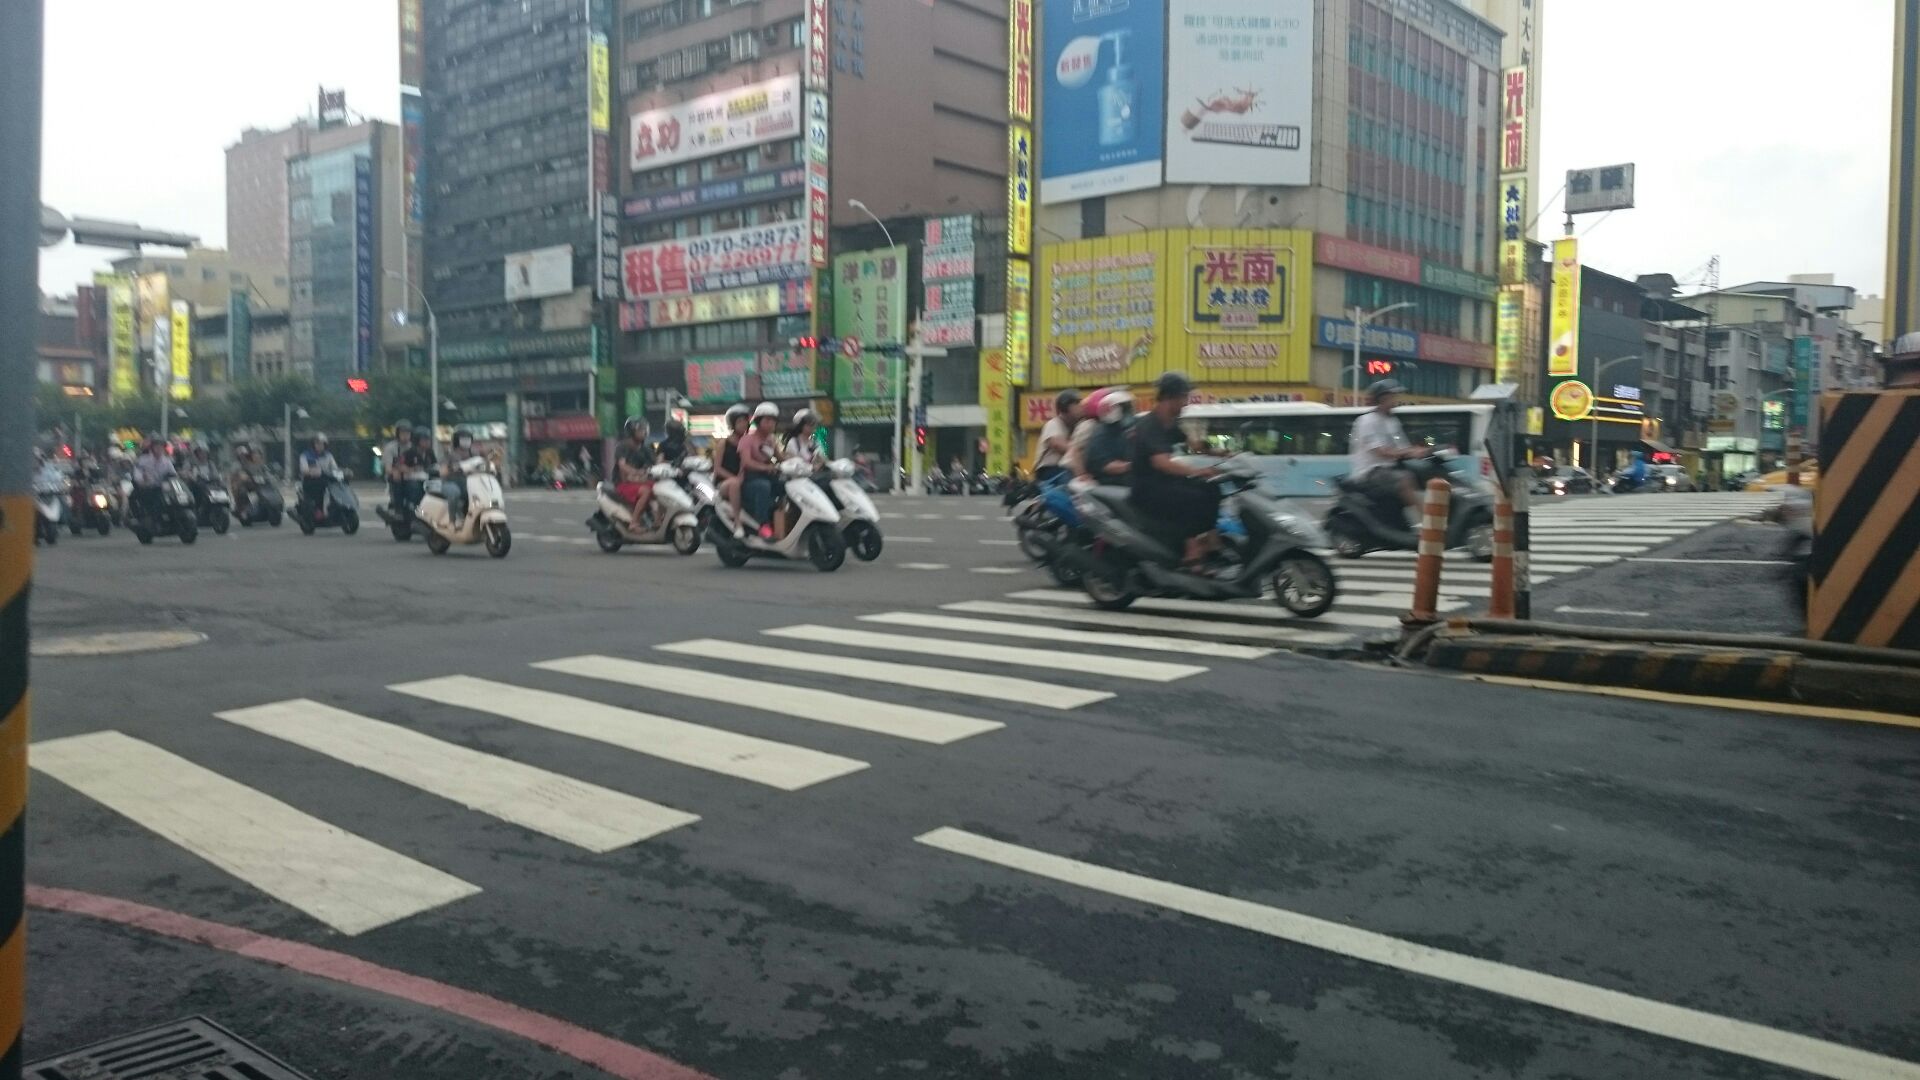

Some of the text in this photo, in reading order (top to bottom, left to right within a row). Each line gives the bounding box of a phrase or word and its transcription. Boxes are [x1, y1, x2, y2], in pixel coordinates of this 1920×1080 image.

[1016, 1, 1029, 113] 光南
[1505, 72, 1524, 169] 光南
[688, 223, 806, 258] 0970-52873
[624, 244, 691, 296] 租售
[1204, 248, 1276, 284] 光南
[1208, 286, 1270, 306] 大批發
